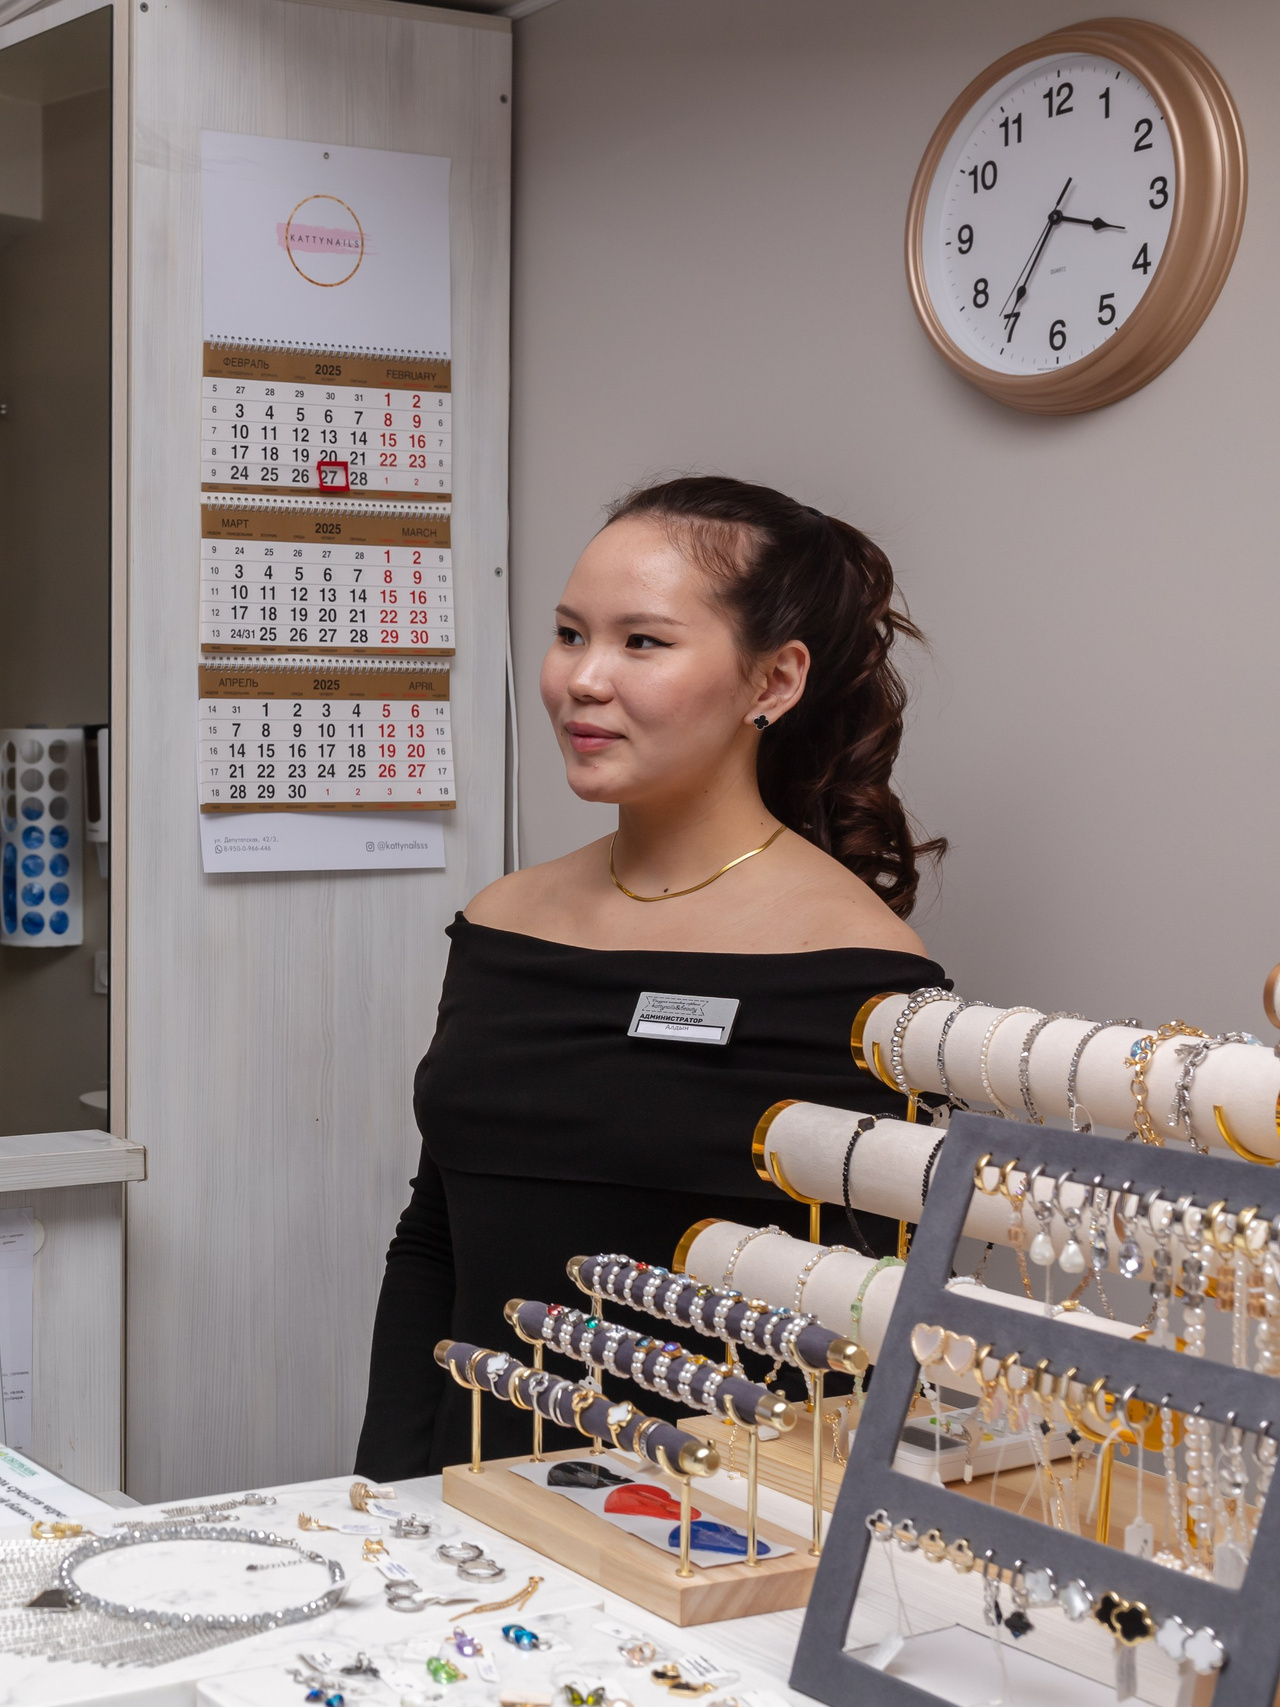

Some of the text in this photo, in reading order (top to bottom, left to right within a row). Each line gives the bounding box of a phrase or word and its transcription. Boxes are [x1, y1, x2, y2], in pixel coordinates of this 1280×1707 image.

[1043, 82, 1074, 118] 12
[1099, 87, 1110, 119] 1
[999, 112, 1022, 146] 11
[1133, 118, 1153, 152] 2
[969, 161, 997, 194] 10
[1149, 176, 1168, 209] 3
[290, 234, 360, 249] KATTYNAILS
[958, 224, 974, 254] 9
[1132, 243, 1151, 275] 4
[973, 278, 989, 308] 8
[1098, 293, 1115, 325] 5
[1004, 312, 1020, 343] 7
[1049, 319, 1066, 350] 6
[223, 357, 437, 381] ФЕВРАЛЬ 2025 FEBRUARY
[385, 393, 420, 408] 1 2
[236, 404, 421, 428] 3 4 5 6 7 8 9
[232, 424, 426, 448] 10 11 12 13 14 15 16
[232, 445, 426, 468] 17 18 19 20 21 22 23
[231, 466, 367, 486] 24 25 26 27 28
[222, 519, 437, 537] МАРТ 2025 MARCH
[384, 550, 421, 564] 1 2
[235, 564, 422, 584] 3 4 5 6 7 8 9
[231, 585, 426, 604] 10 11 12 13 14 15 16
[232, 606, 427, 624] 17 18 19 20 21 22 23
[231, 627, 428, 644] 24/31 25 26 27 28 29 30
[219, 678, 435, 691] АПРЕЛЬ 2025 APRIL
[263, 703, 419, 718] 1 2 3 4 5 6
[232, 723, 424, 738] 7 8 9 10 11 12 13
[229, 744, 425, 758] 14 15 16 17 18 19 20
[230, 764, 425, 778] 21 22 23 24 25 26 27
[230, 784, 306, 798] 28 29 30
[377, 840, 428, 851] @kattynailsss
[639, 1013, 704, 1024] АДМИНИСТРАТОР
